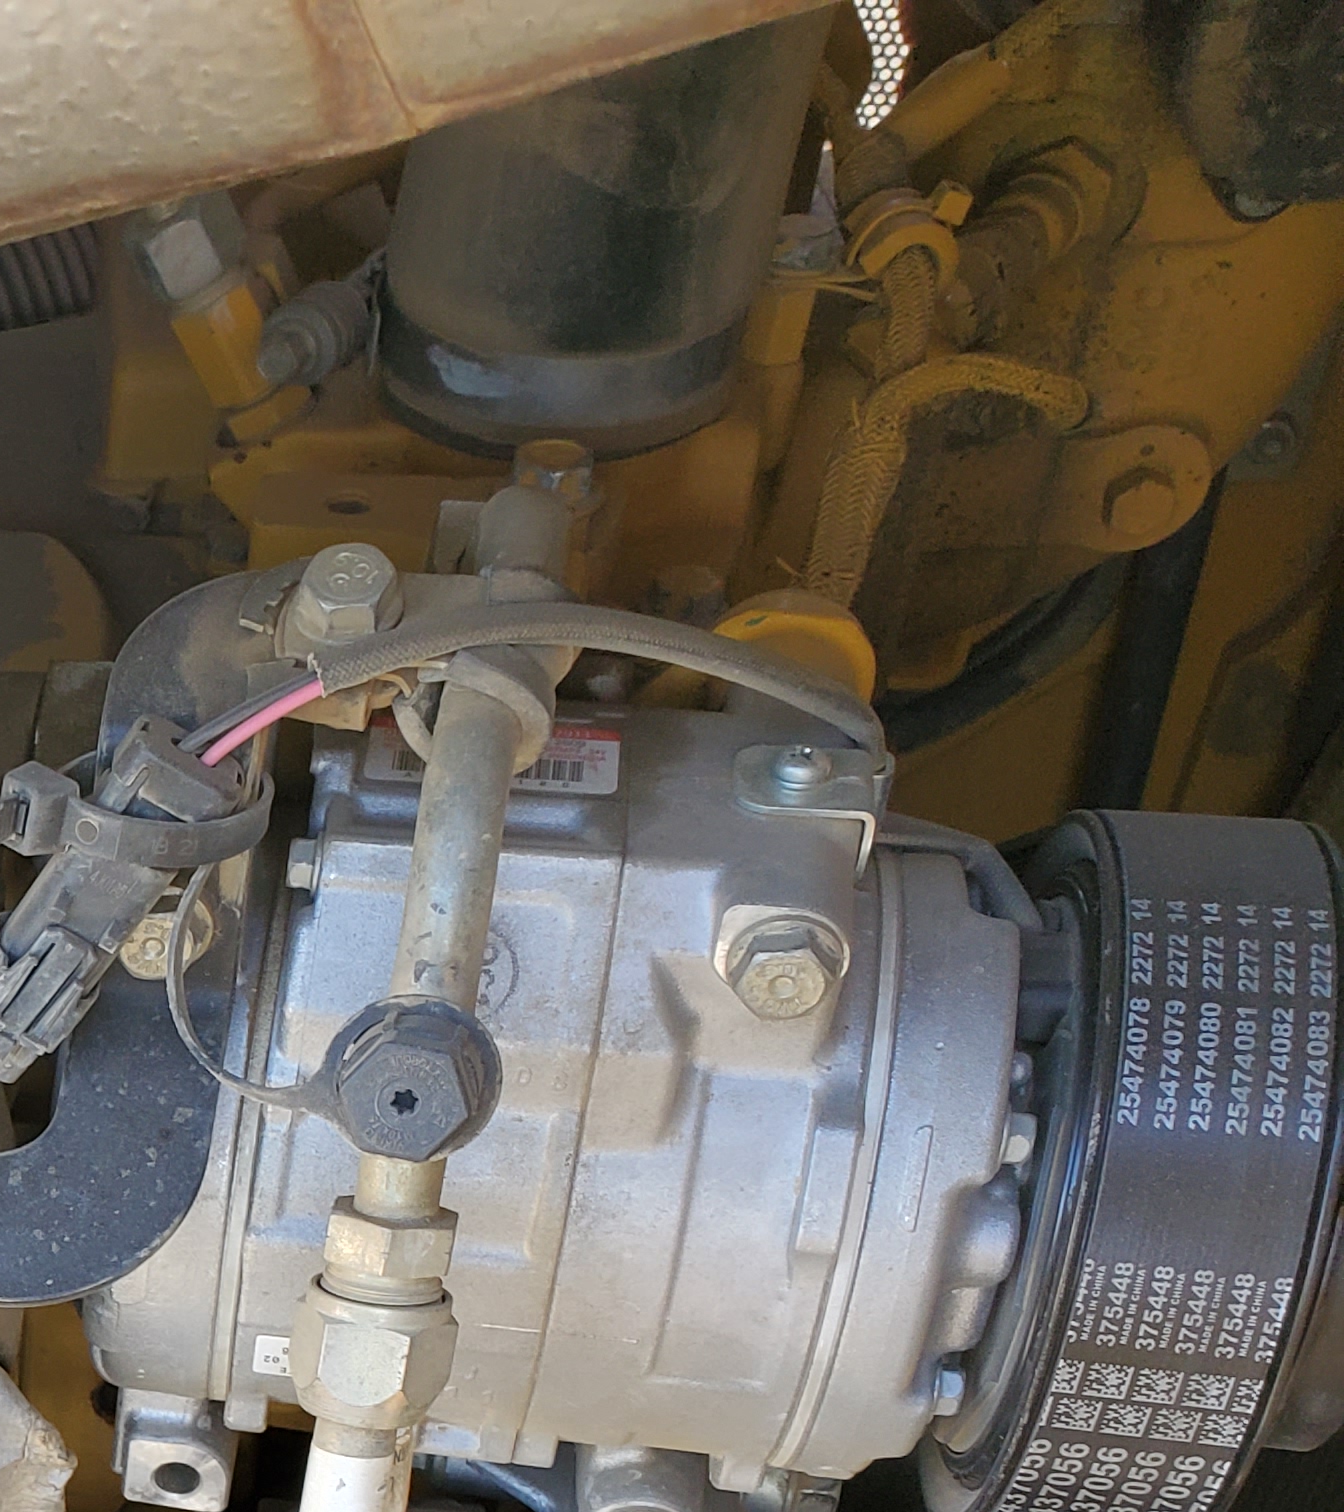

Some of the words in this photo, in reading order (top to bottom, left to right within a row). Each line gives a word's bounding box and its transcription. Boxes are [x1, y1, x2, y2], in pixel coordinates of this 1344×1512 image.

[1131, 898, 1152, 921] 14
[1166, 900, 1187, 923] 14
[1201, 902, 1222, 925] 14
[1237, 904, 1258, 927] 14
[1271, 906, 1293, 929] 14
[1308, 909, 1330, 931] 14
[1131, 931, 1153, 986] 2272
[1166, 934, 1188, 988] 2272
[1202, 936, 1224, 990] 2272
[1238, 938, 1260, 993] 2272
[1273, 940, 1296, 995] 2272
[1310, 943, 1333, 998] 2272
[1117, 997, 1151, 1126] 25474078
[1153, 1000, 1186, 1131] 25474079
[1188, 1002, 1222, 1132] 25474080
[1225, 1007, 1258, 1136] 25474081
[1260, 1008, 1294, 1137] 25474082
[1297, 1010, 1330, 1142] 25474083
[1091, 1265, 1107, 1297] CHINA
[1131, 1269, 1146, 1301] CHINA
[1170, 1273, 1186, 1305] CHINA
[1211, 1276, 1227, 1309] CHINA
[1250, 1280, 1267, 1313] CHINA
[1088, 1300, 1098, 1311] IN
[1095, 1262, 1134, 1347] 375448
[1127, 1303, 1138, 1315] IN
[1134, 1265, 1175, 1351] 375448
[1167, 1307, 1178, 1319] IN
[1174, 1269, 1215, 1355] 375448
[1207, 1311, 1218, 1323] IN
[1214, 1273, 1255, 1360] 375448
[1080, 1313, 1096, 1341] MADE
[1119, 1317, 1134, 1345] MADE
[1159, 1321, 1175, 1349] MADE
[1246, 1315, 1258, 1327] IN
[1198, 1325, 1214, 1353] MADE
[1238, 1328, 1255, 1358] MADE
